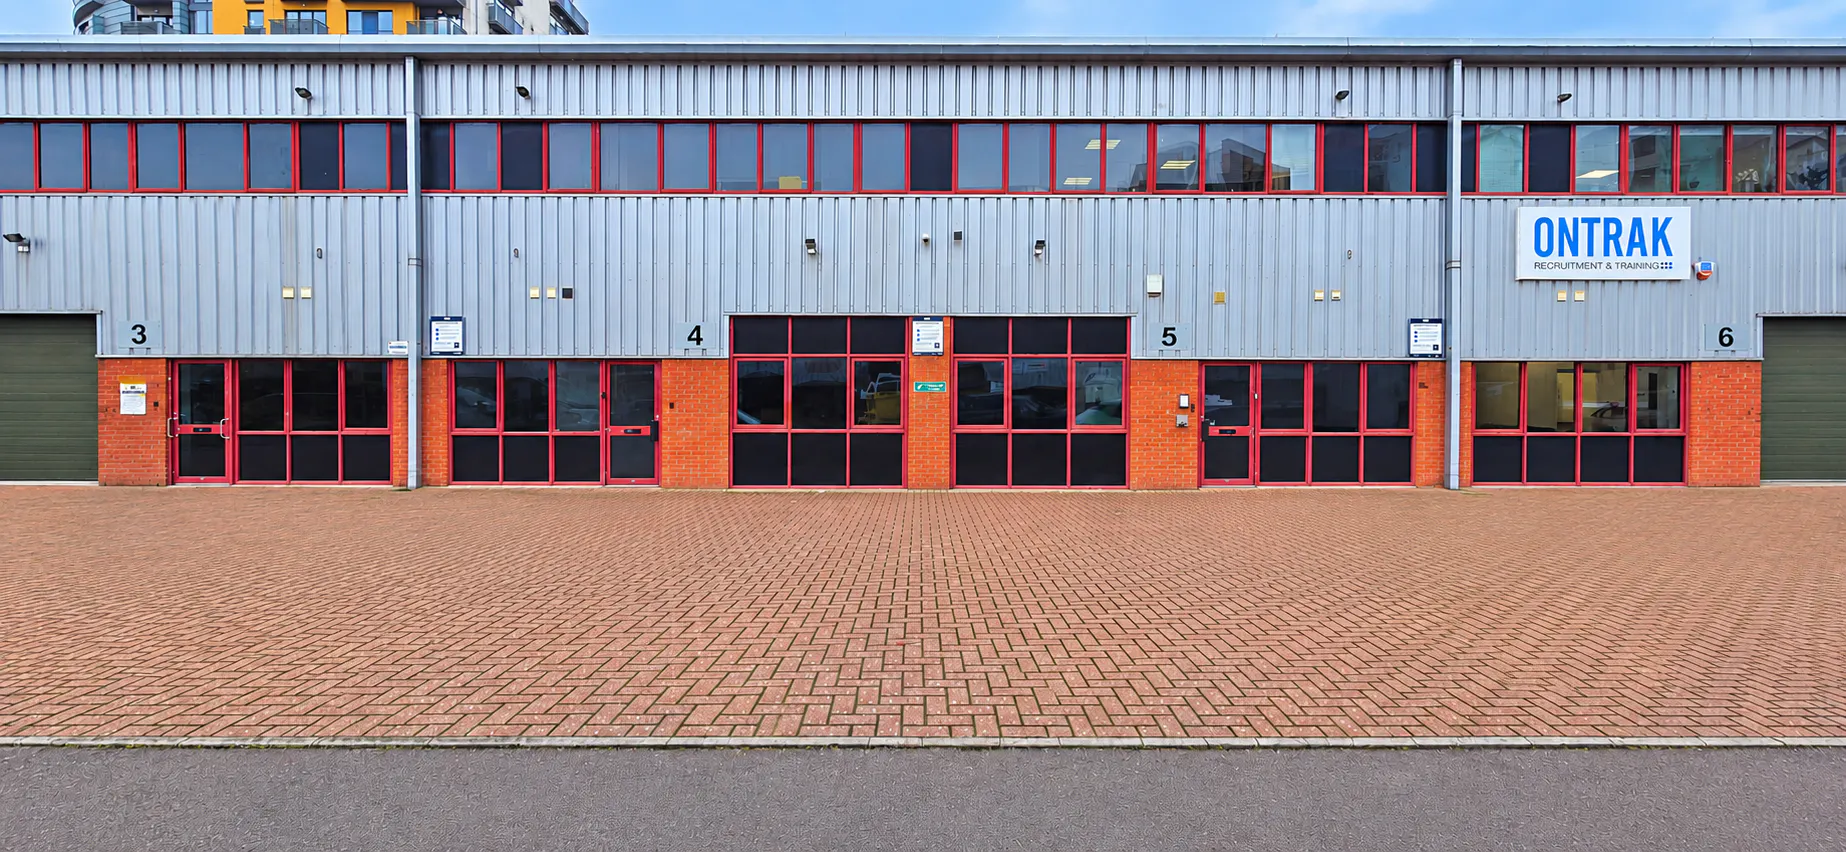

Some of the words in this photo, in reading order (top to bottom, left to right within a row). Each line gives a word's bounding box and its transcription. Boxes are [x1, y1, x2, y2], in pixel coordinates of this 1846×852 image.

[1534, 217, 1673, 258] ONTRAK
[1534, 261, 1603, 270] RECRUITMENT
[1605, 261, 1612, 270] &
[1614, 261, 1660, 270] TRAINING
[131, 324, 147, 345] 3
[687, 325, 704, 346] 4
[1162, 327, 1178, 347] 5
[1718, 327, 1735, 348] 6
